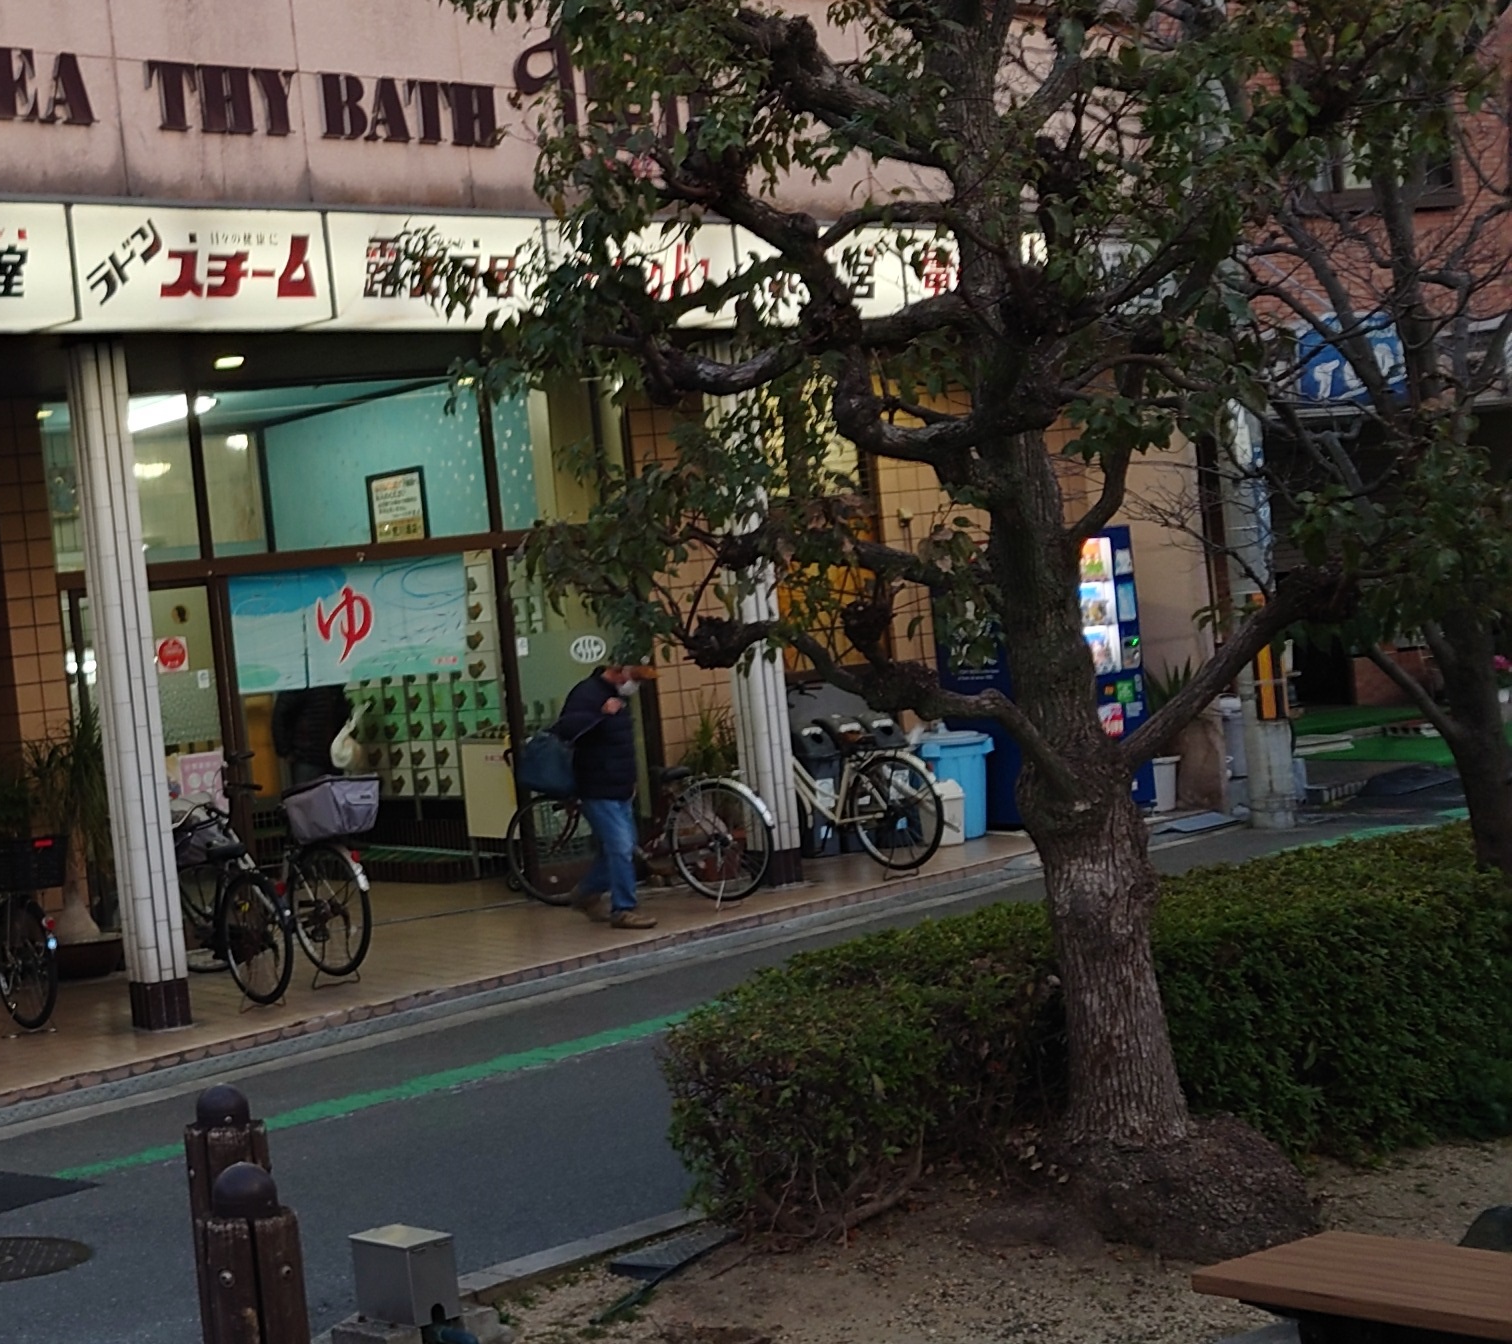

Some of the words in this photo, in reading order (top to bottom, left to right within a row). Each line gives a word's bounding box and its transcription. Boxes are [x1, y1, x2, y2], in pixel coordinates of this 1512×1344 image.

[147, 59, 298, 137] THY
[319, 71, 498, 149] BATH
[86, 217, 164, 306] ラドン
[160, 233, 317, 299] スチーム
[316, 584, 373, 665] ゆ
